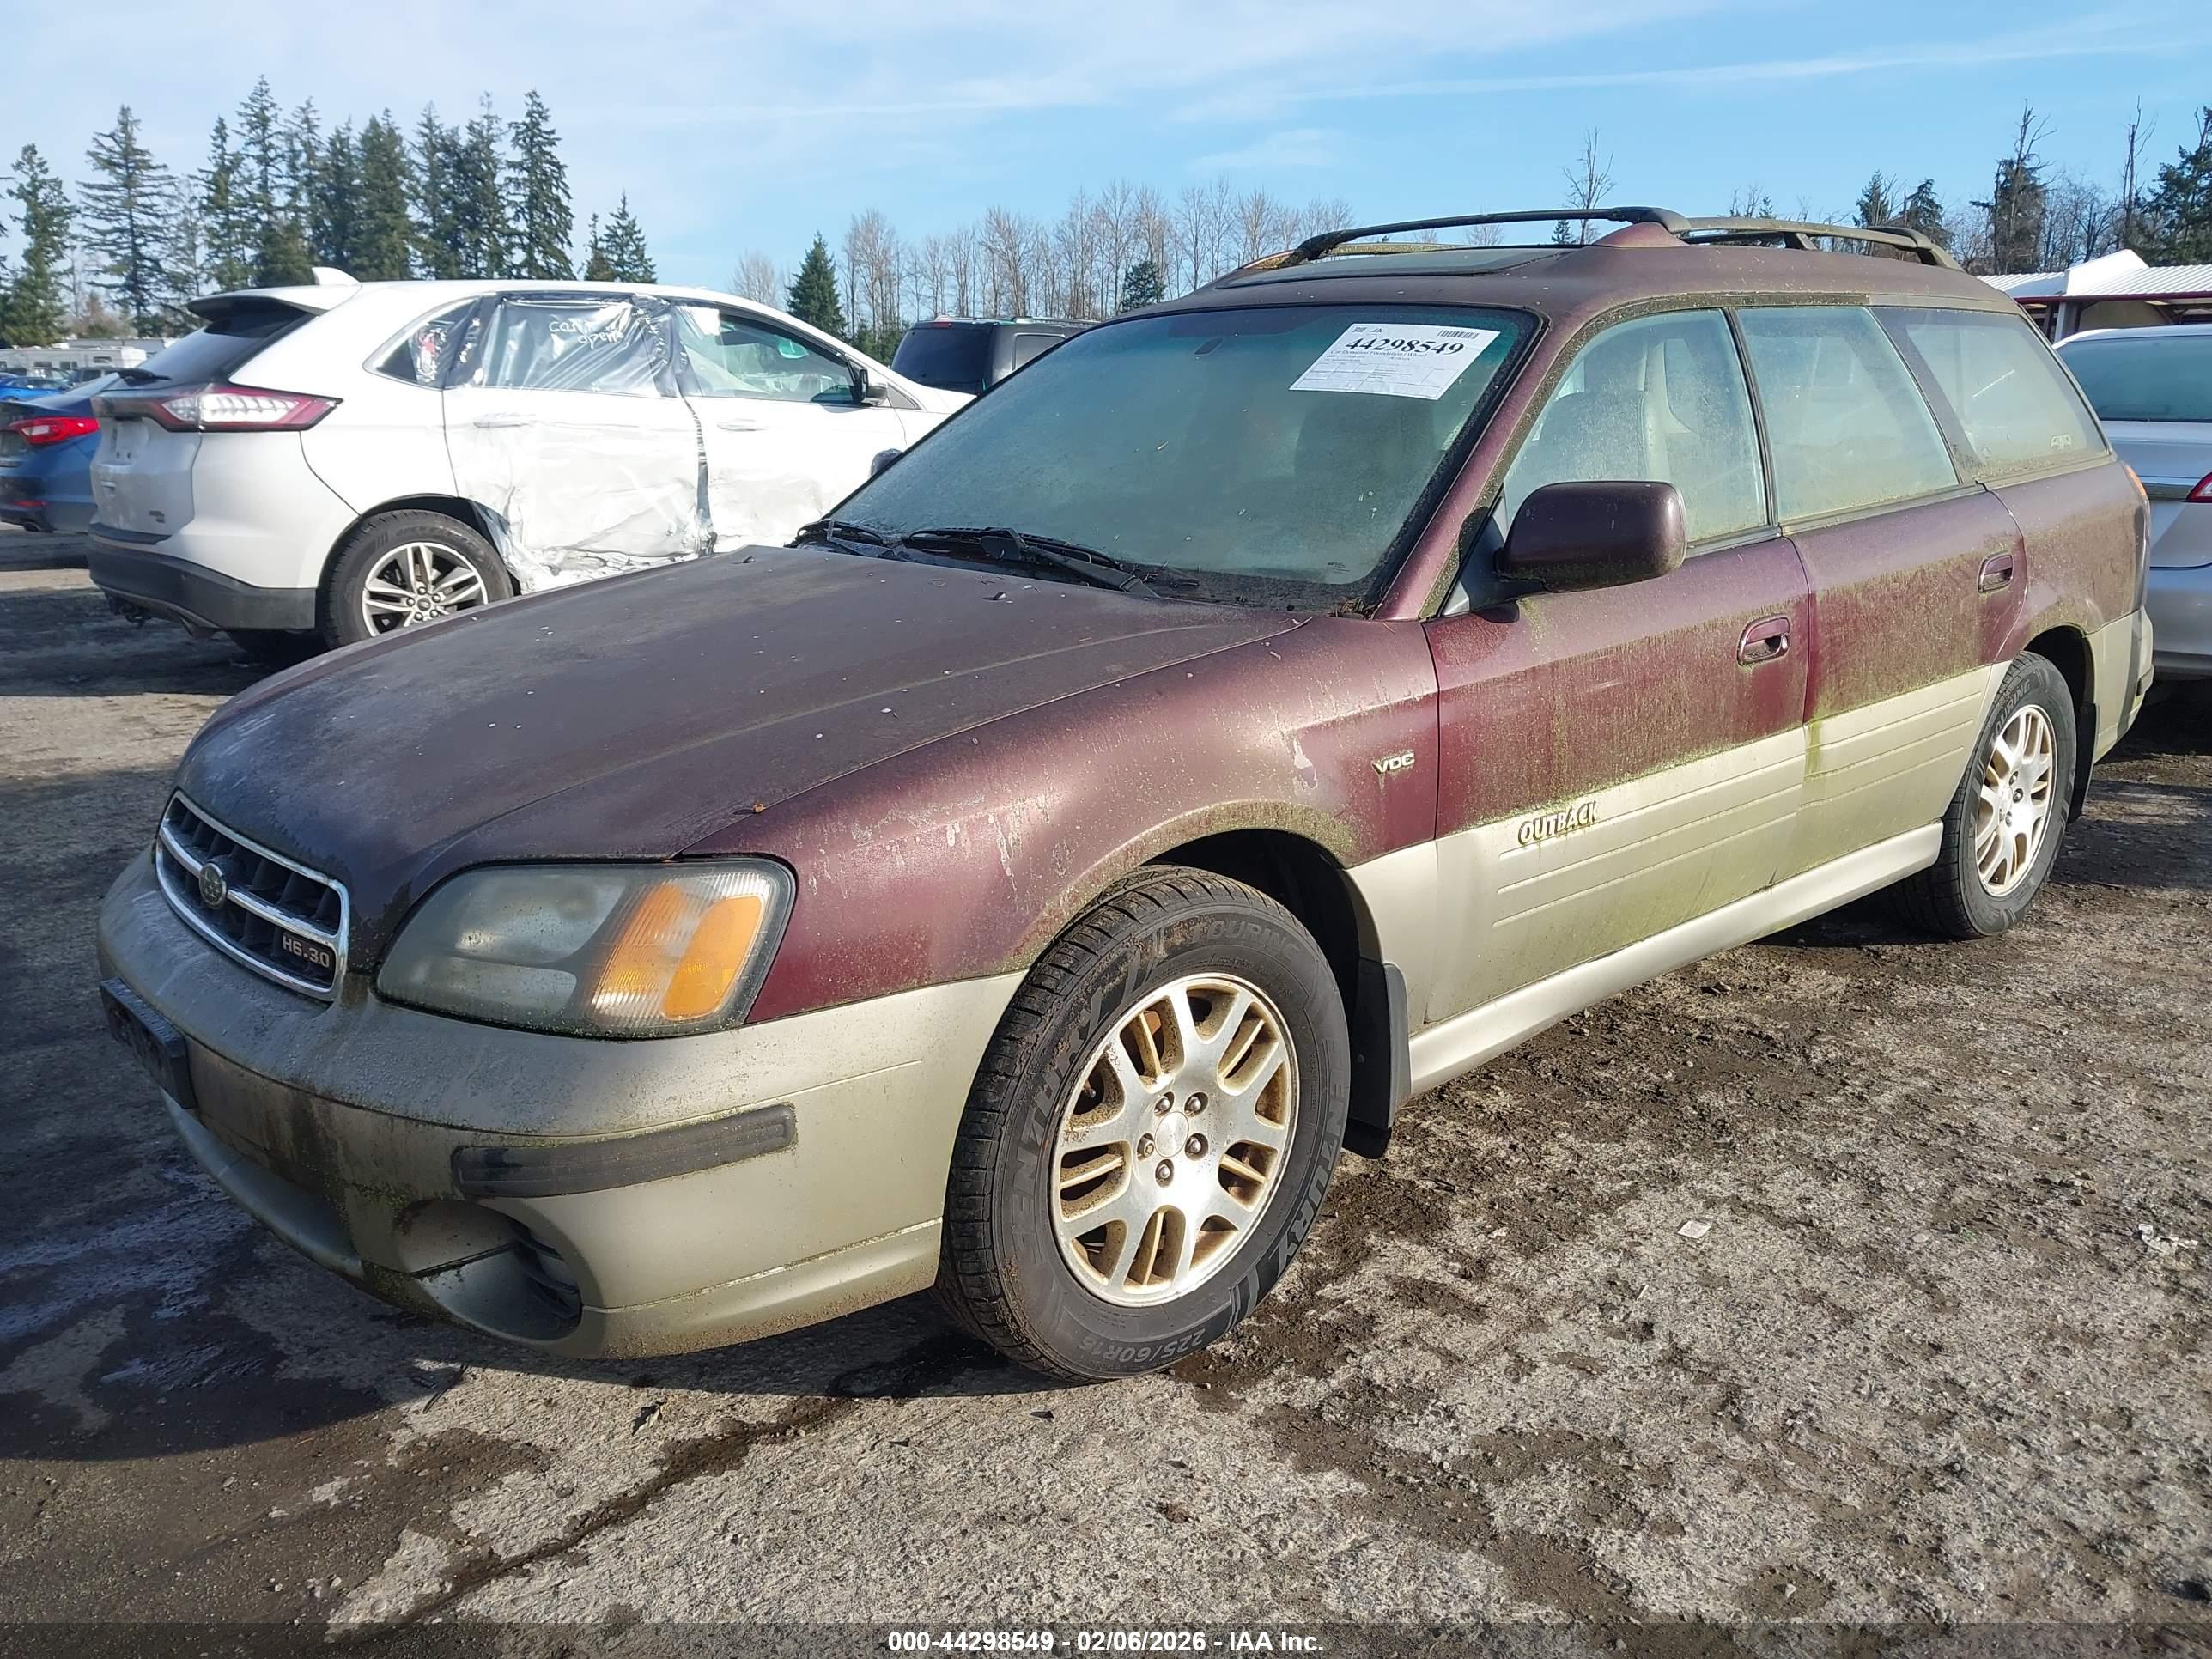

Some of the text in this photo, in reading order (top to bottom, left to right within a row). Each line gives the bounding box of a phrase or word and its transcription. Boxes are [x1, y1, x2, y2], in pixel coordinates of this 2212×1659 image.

[1346, 337, 1465, 355] 44298549
[1372, 752, 1415, 774] VDC
[1517, 800, 1598, 845] OUTBACK
[1078, 1327, 1206, 1364] 225/60R16
